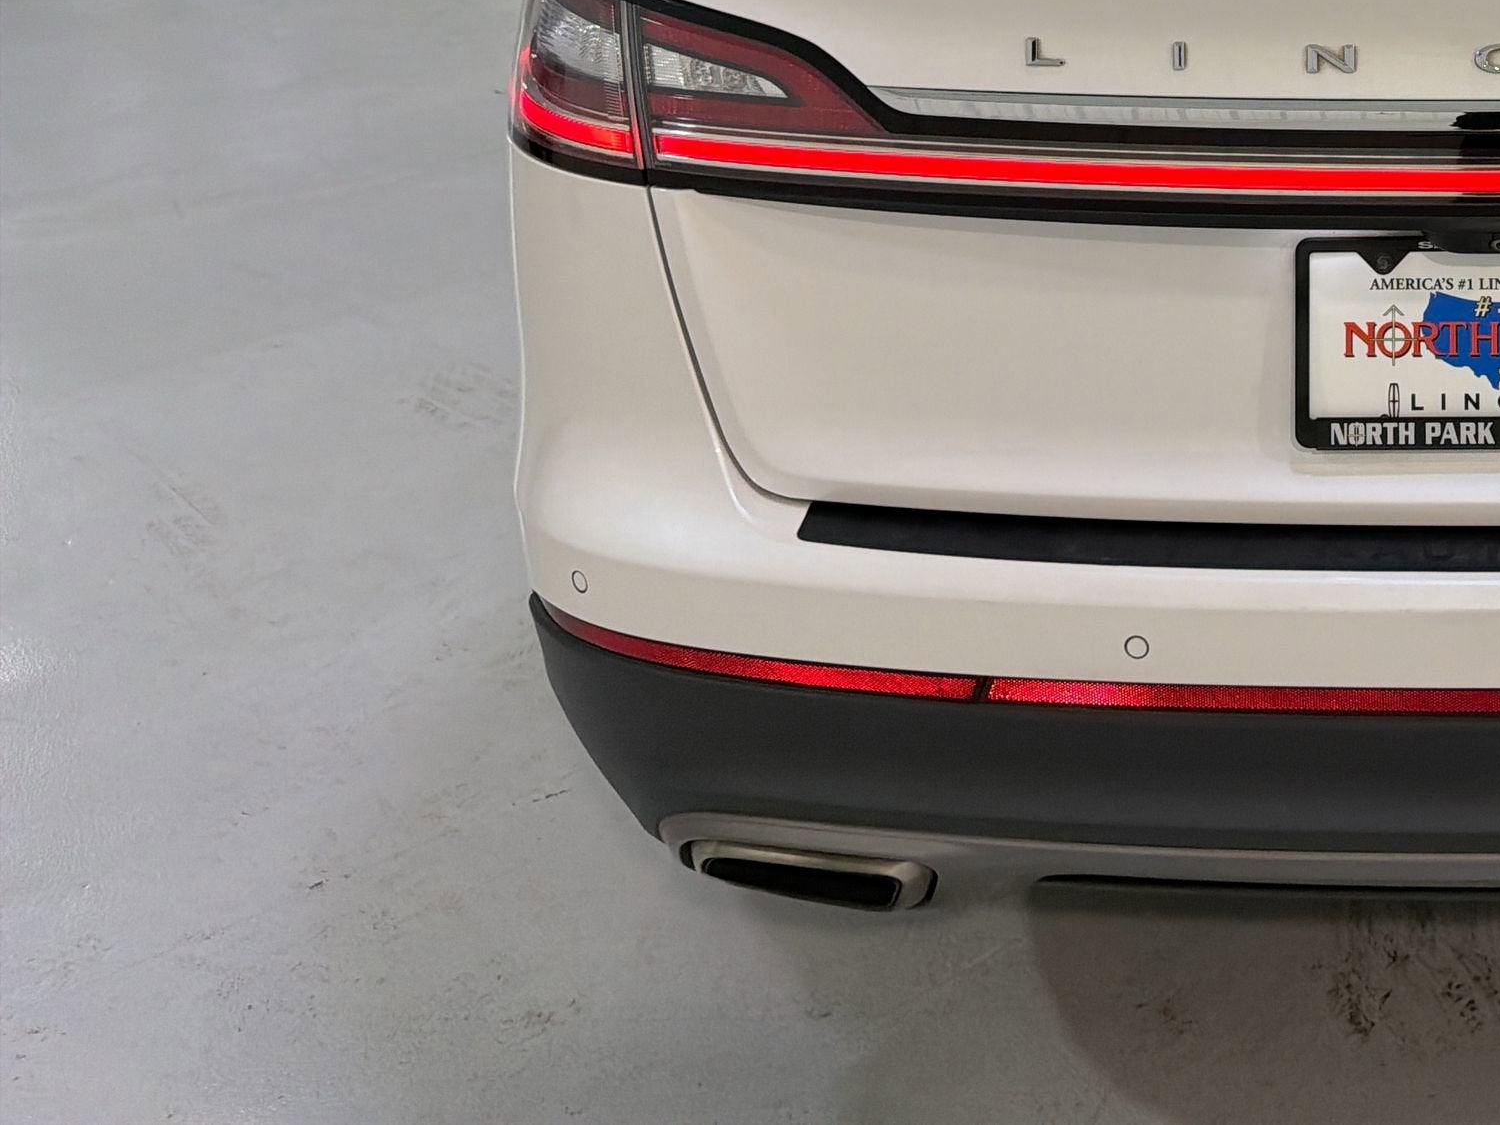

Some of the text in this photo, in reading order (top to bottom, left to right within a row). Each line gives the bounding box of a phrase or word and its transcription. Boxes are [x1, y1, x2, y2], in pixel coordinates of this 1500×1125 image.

[1369, 277, 1454, 291] AMERICA'S
[1458, 277, 1474, 291] #1
[1343, 320, 1500, 359] NORTH
[1330, 421, 1416, 446] NORTH
[1424, 421, 1497, 446] PARK
